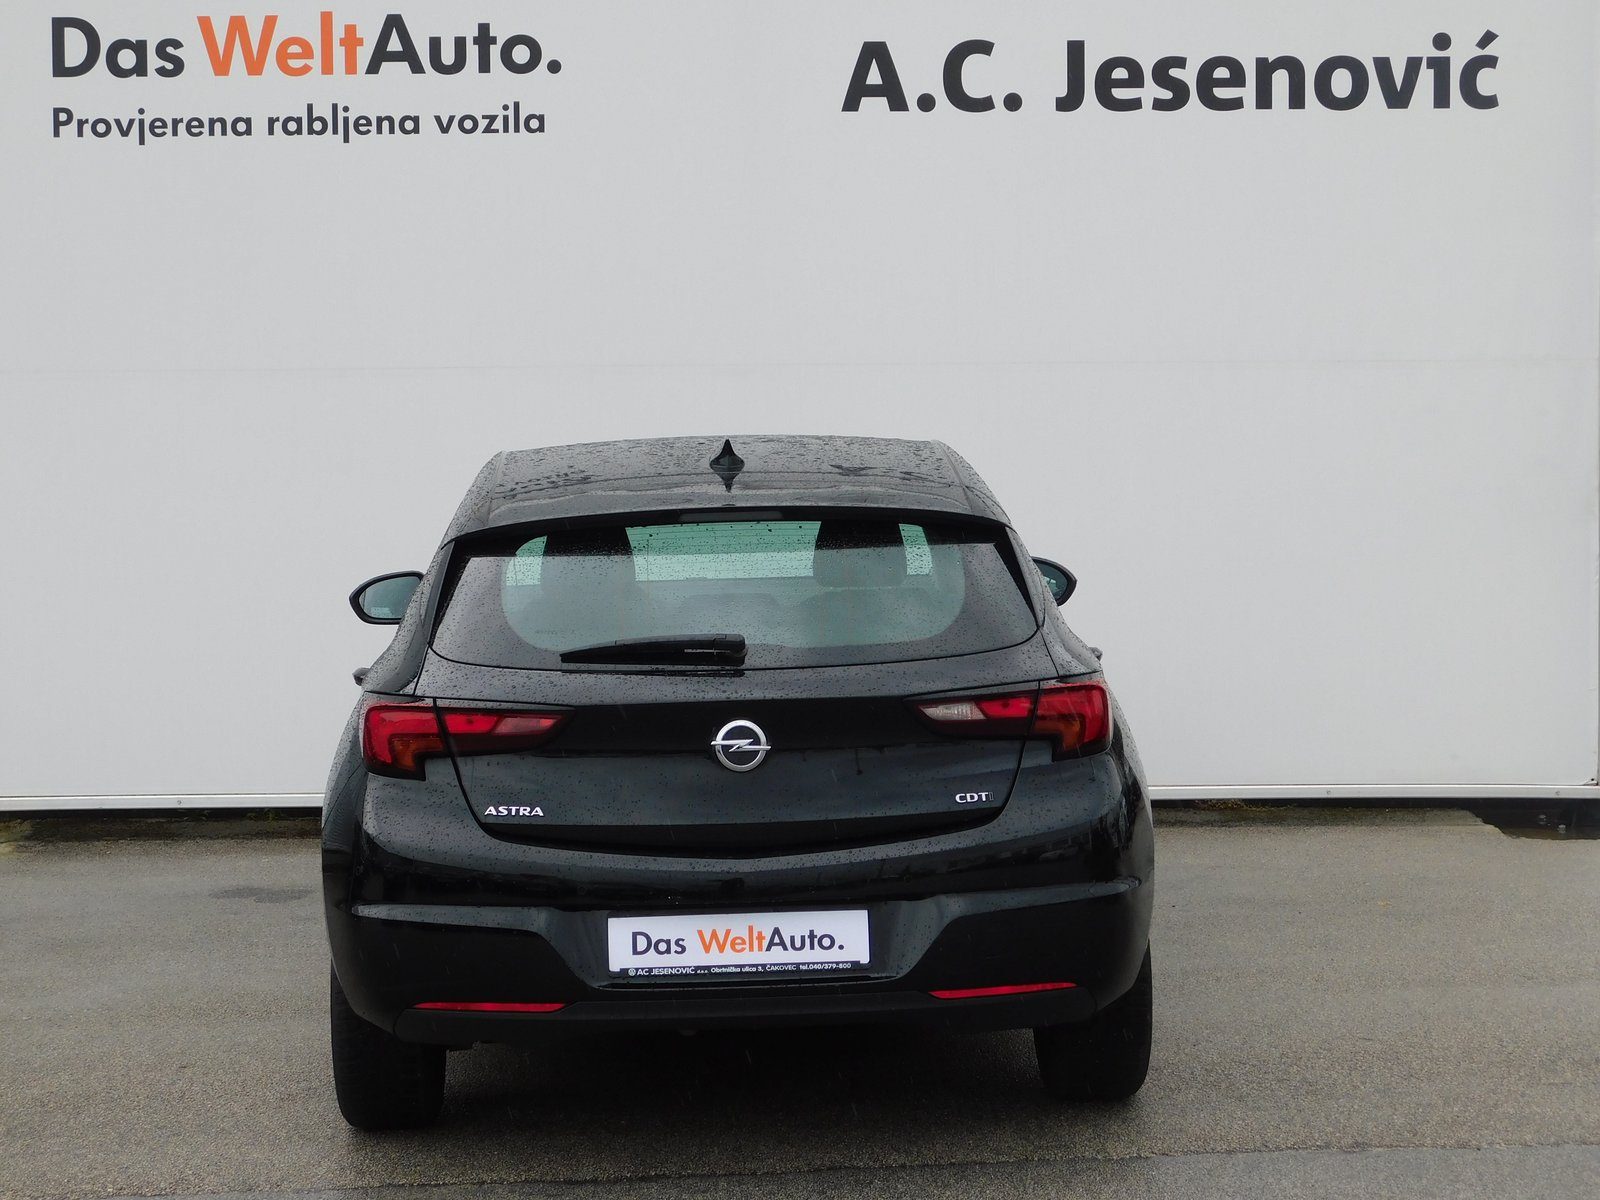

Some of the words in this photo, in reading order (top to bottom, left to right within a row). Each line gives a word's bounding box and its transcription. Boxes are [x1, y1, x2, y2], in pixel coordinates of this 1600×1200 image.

[52, 17, 184, 78] Das
[198, 12, 561, 78] WeltAuto.
[842, 40, 1022, 113] A.C.
[1056, 30, 1498, 112] Jesenović
[53, 106, 252, 146] Provjerena
[268, 103, 419, 144] rabljena
[434, 101, 544, 135] vozila
[484, 806, 544, 816] ASTRA
[631, 931, 686, 956] Das
[697, 925, 845, 954] WeltAuto.
[637, 968, 649, 976] AC
[651, 967, 695, 976] JESENOVIĆ
